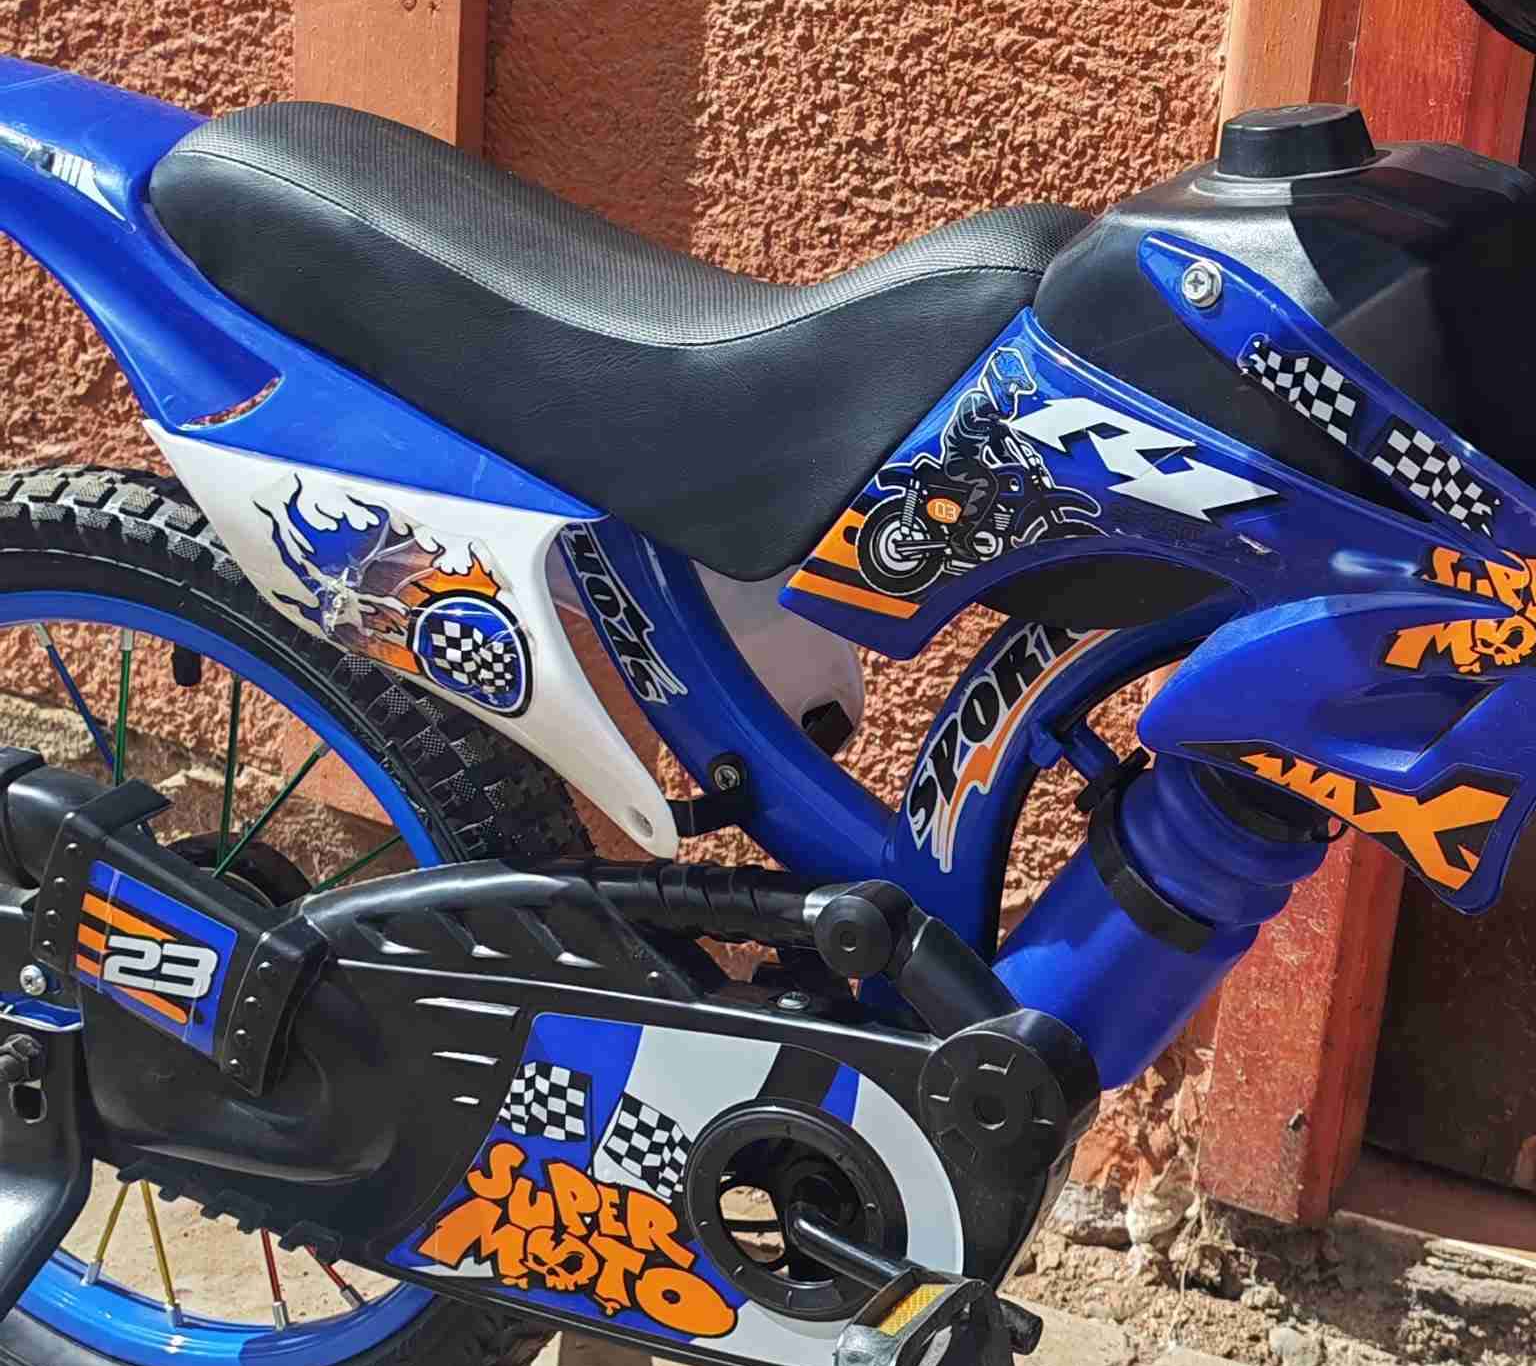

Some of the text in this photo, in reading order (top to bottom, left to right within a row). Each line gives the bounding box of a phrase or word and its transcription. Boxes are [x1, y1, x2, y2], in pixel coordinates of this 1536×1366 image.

[102, 934, 219, 999] 23
[416, 1197, 738, 1337] MOTO
[466, 1141, 696, 1269] SUPER
